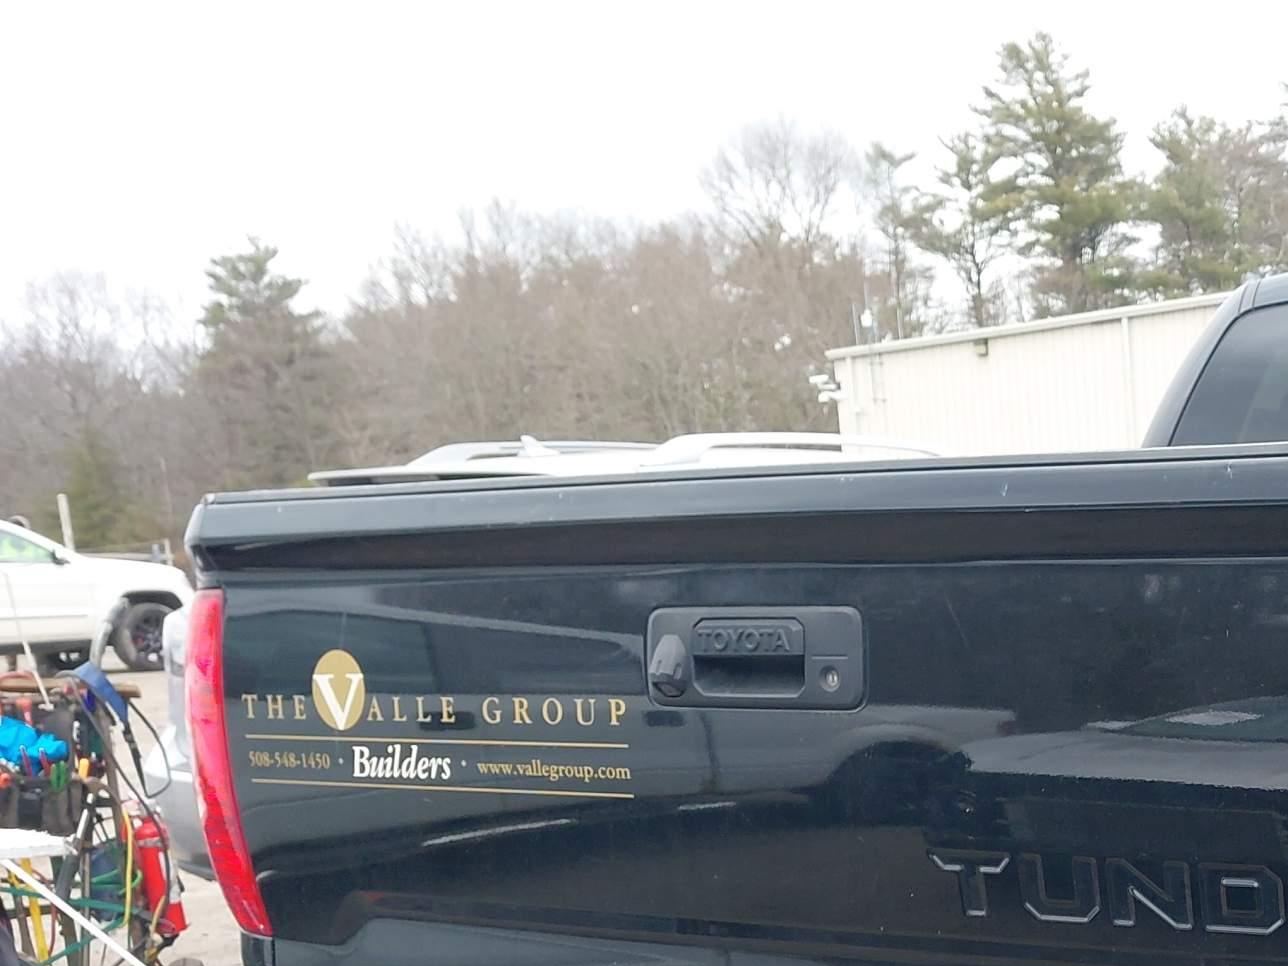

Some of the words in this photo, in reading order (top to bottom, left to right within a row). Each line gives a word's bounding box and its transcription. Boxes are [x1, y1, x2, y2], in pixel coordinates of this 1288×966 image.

[698, 627, 791, 652] TOYOTA
[241, 693, 307, 720] THE
[312, 673, 456, 731] VALLE
[482, 696, 626, 727] GROUP
[249, 750, 331, 769] 508-548-1450
[352, 743, 451, 780] Builders
[476, 758, 632, 783] www.vallegroup.com
